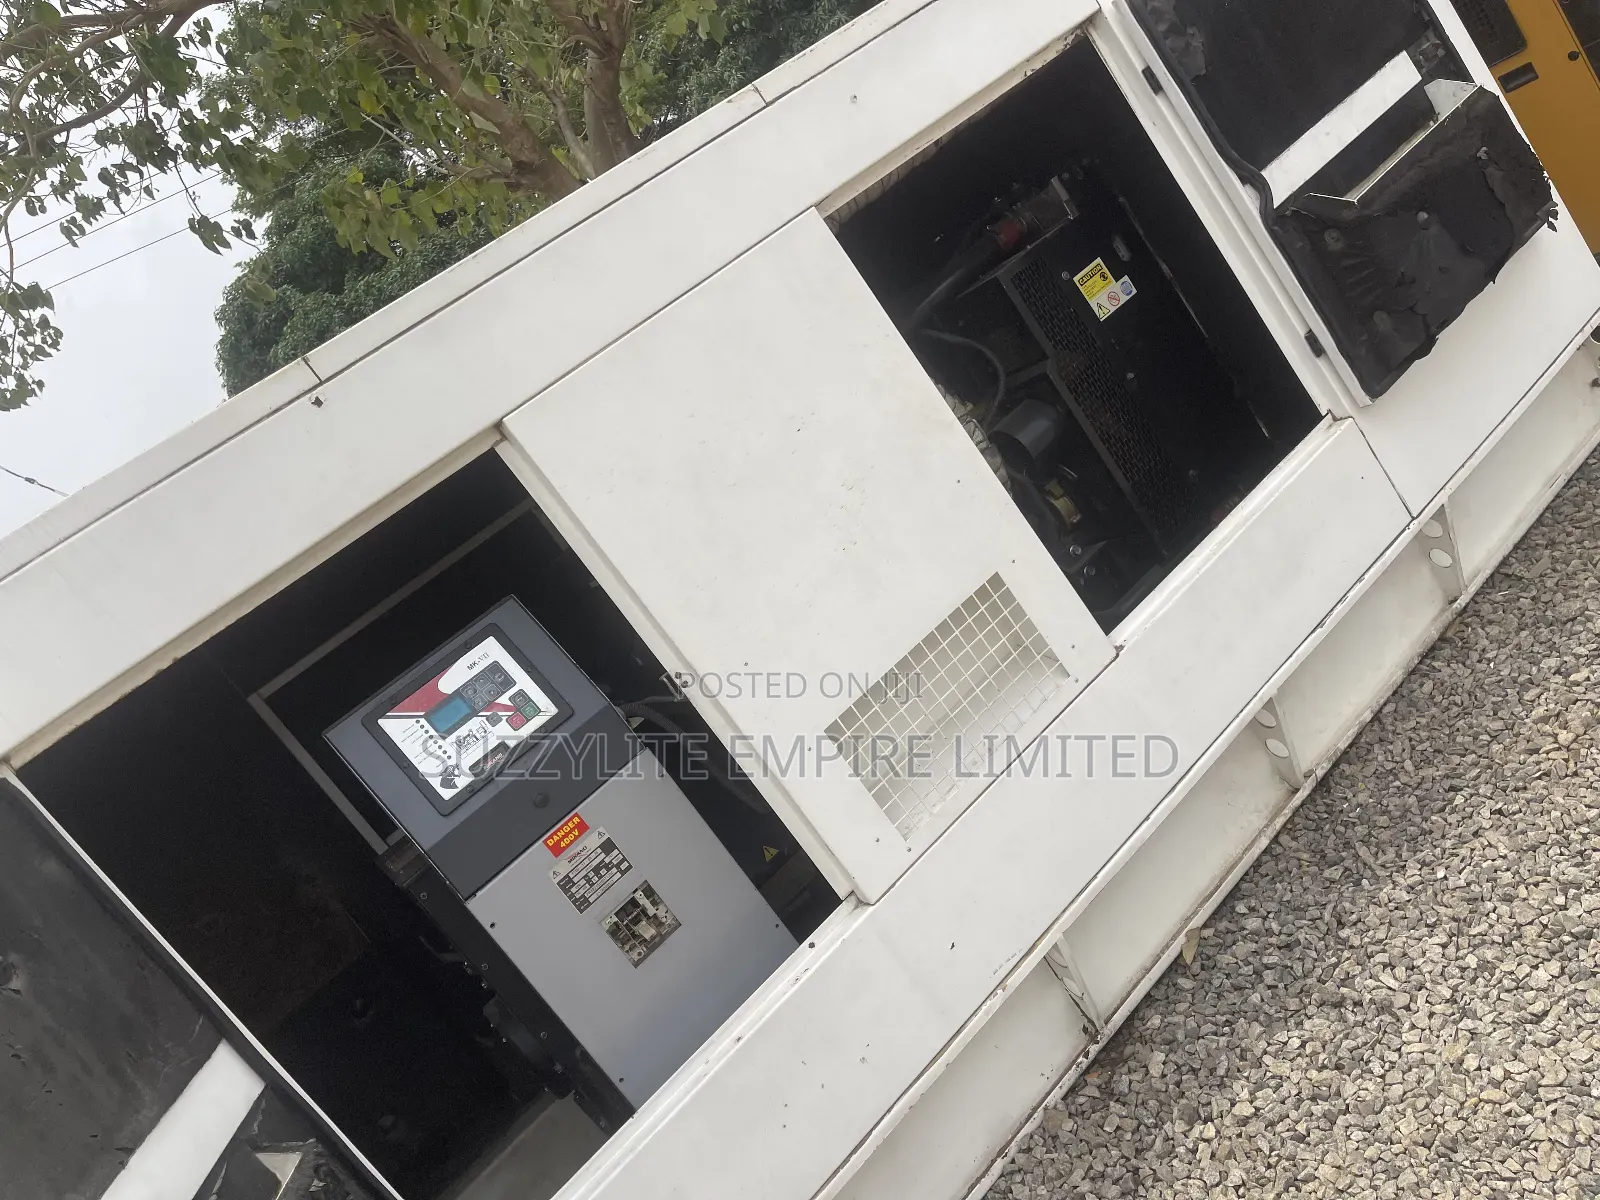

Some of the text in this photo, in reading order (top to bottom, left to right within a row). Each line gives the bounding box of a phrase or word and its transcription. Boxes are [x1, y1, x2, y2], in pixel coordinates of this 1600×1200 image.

[1079, 264, 1102, 285] CAUTION
[546, 816, 581, 847] DANGER
[560, 828, 580, 848] 400V
